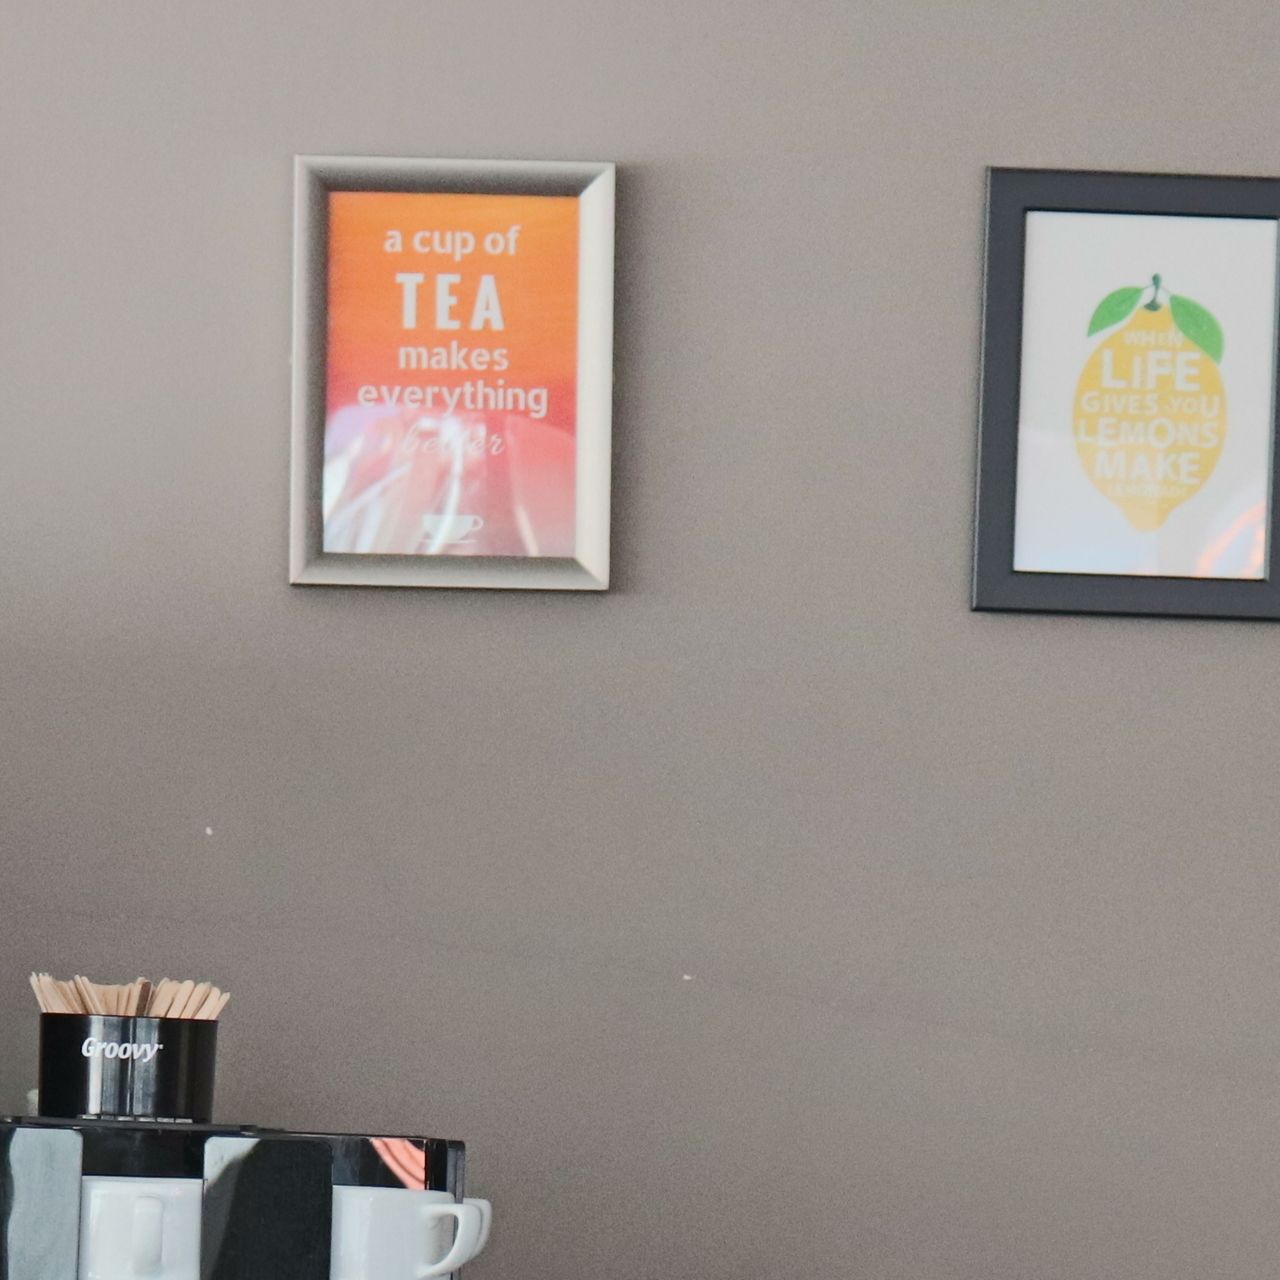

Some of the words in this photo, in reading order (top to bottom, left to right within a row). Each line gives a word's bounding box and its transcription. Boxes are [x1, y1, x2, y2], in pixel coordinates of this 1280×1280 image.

[383, 229, 403, 253] a
[412, 229, 476, 261] cup
[484, 225, 522, 257] of
[395, 272, 505, 331] TEA
[1124, 329, 1184, 348] WHEN
[398, 341, 510, 371] makes
[1101, 349, 1201, 391] LIFE
[356, 380, 549, 418] everything
[1081, 391, 1159, 415] GIVES
[1167, 394, 1220, 419] YOU
[1077, 417, 1219, 449] LEMONS
[1094, 450, 1201, 484] MAKE
[81, 1037, 160, 1062] Groovy
